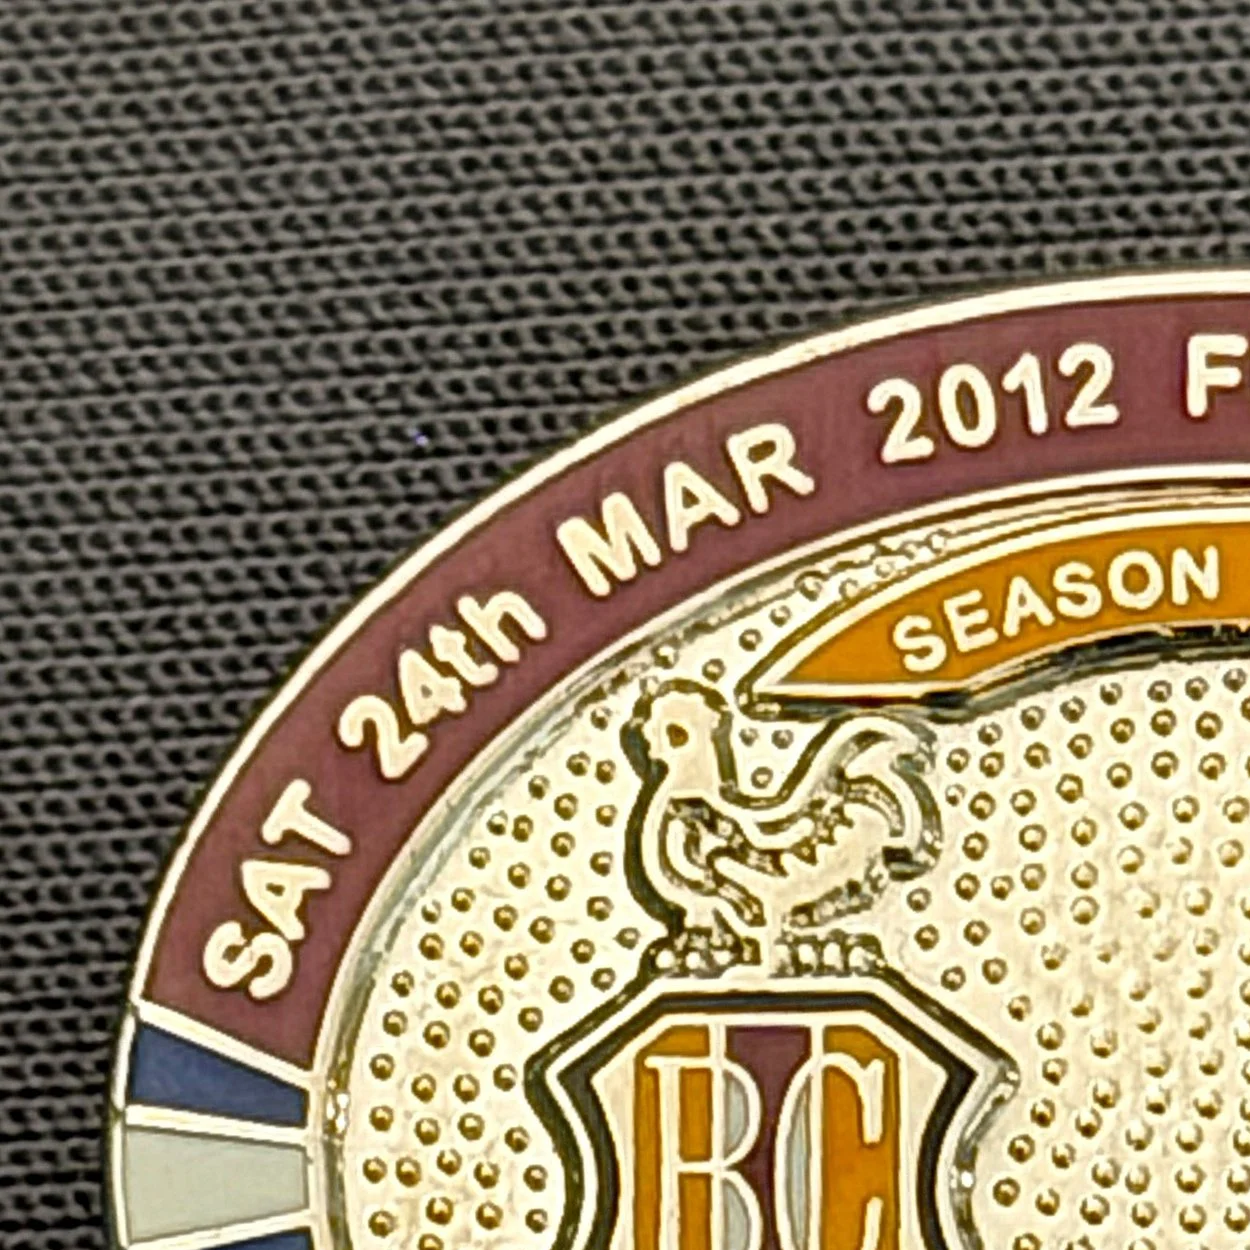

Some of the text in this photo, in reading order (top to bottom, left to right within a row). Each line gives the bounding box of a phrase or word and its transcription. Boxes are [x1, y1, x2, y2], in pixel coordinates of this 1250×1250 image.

[202, 778, 352, 1000] SAT
[338, 590, 548, 781] 24th
[556, 422, 815, 598] MAR
[867, 342, 1120, 464] 2012
[892, 547, 1220, 674] SEASON
